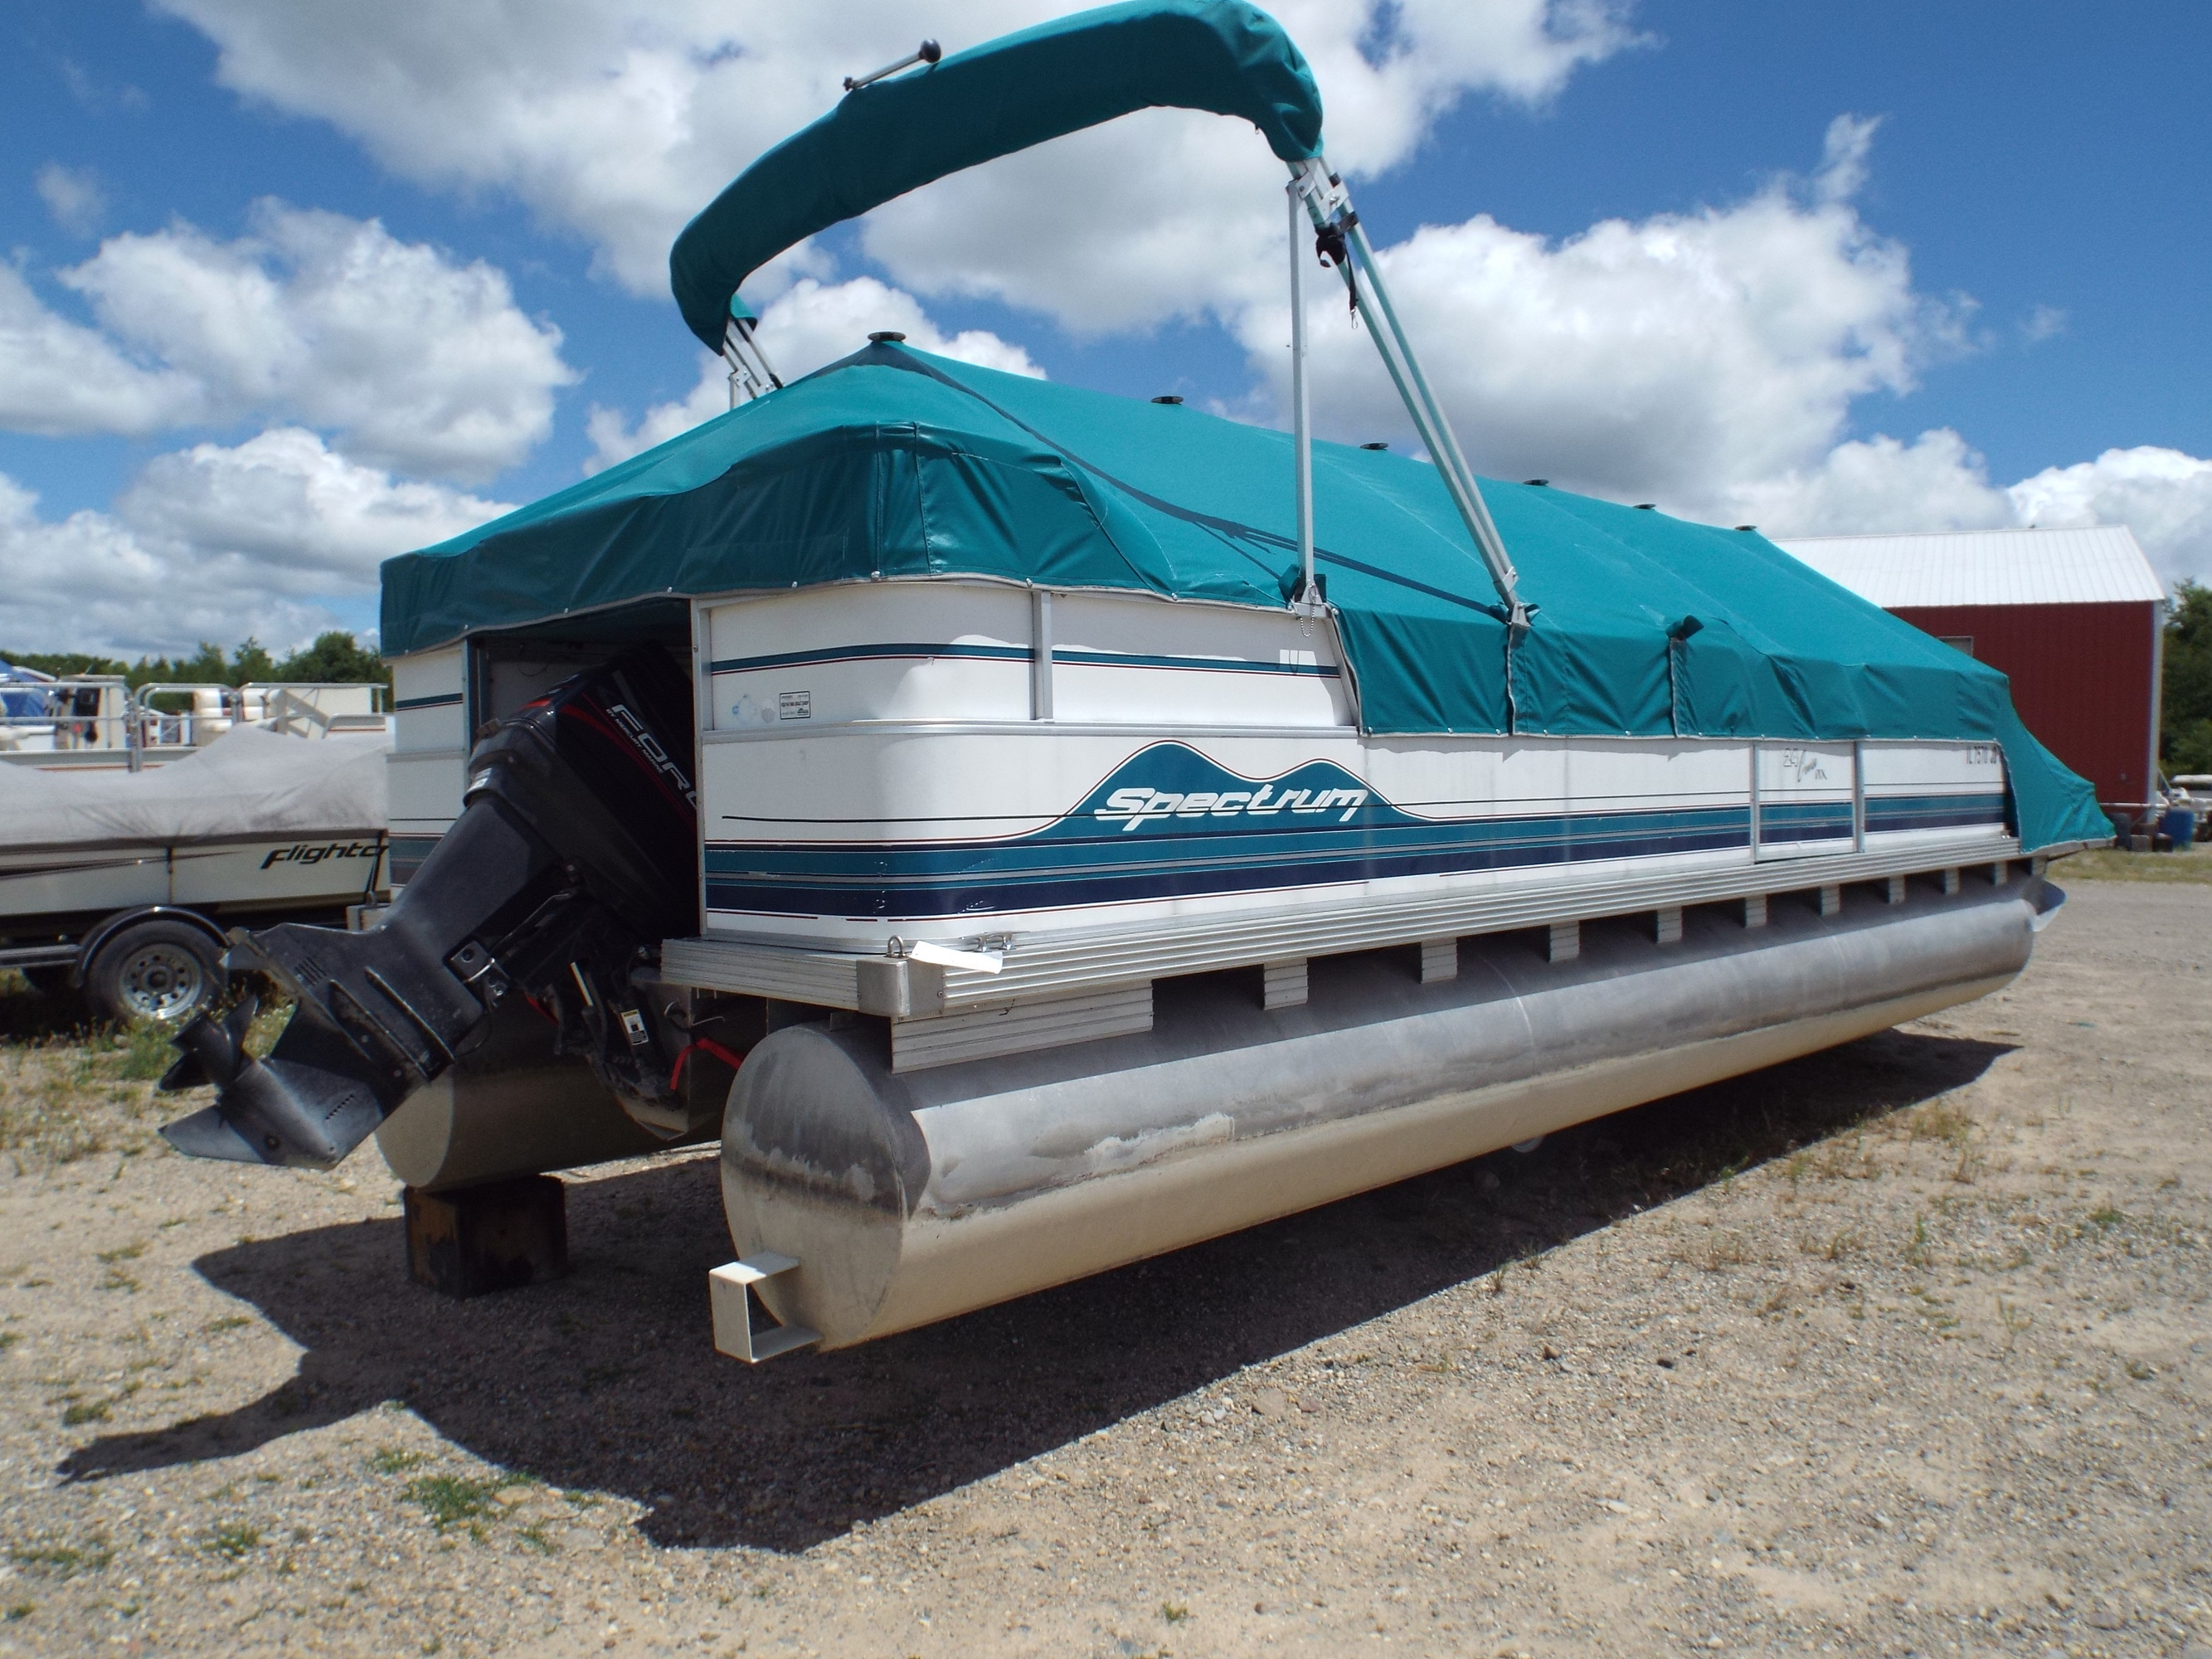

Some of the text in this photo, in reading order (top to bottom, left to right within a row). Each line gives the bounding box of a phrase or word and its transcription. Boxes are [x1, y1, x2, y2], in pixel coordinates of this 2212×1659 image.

[615, 718, 643, 747] MERCURY
[642, 749, 664, 774] MARINE
[1094, 784, 1368, 831] Spectrum
